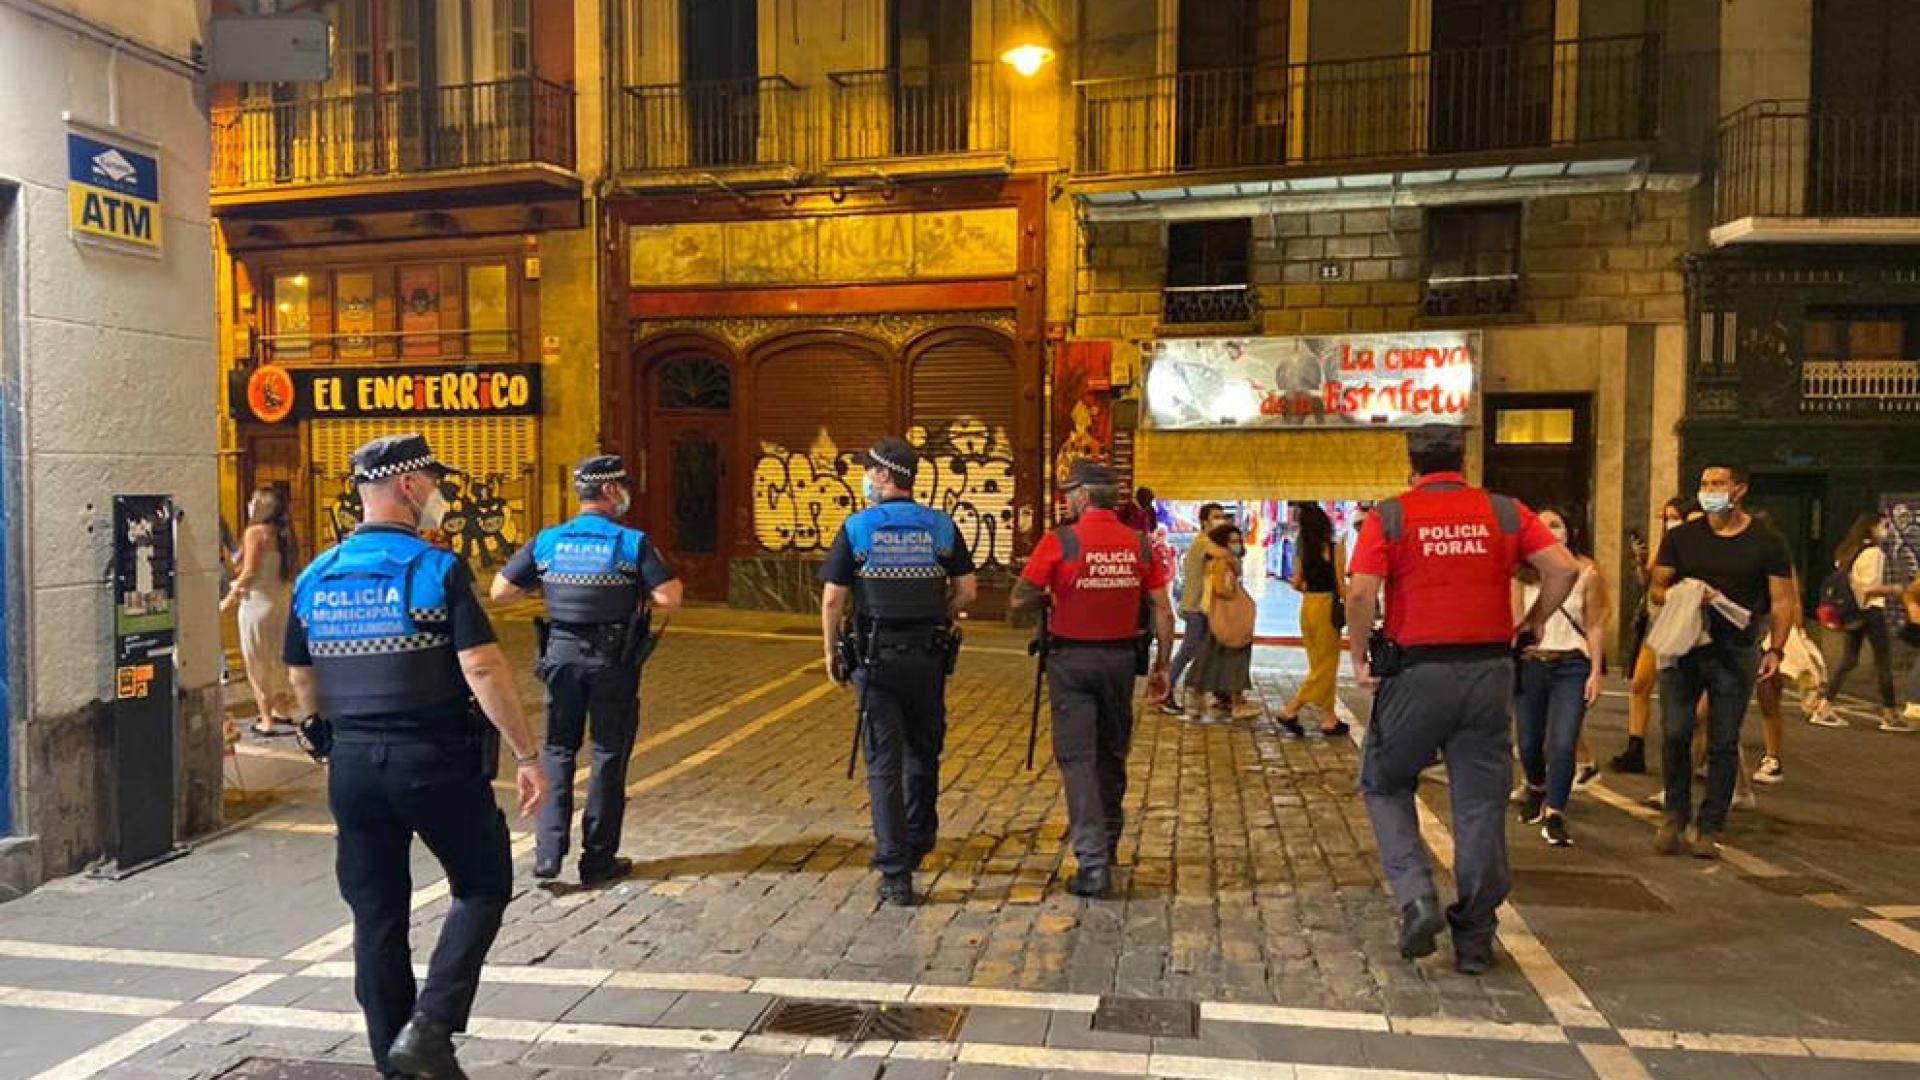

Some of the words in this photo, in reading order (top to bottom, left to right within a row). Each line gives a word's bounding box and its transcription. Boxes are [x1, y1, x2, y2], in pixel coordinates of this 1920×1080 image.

[82, 192, 152, 240] ATM
[1341, 342, 1375, 371] La
[314, 377, 346, 411] EL
[1423, 539, 1488, 557] FORAL
[1089, 564, 1134, 577] FORAL
[312, 606, 402, 622] MUNICIPAL
